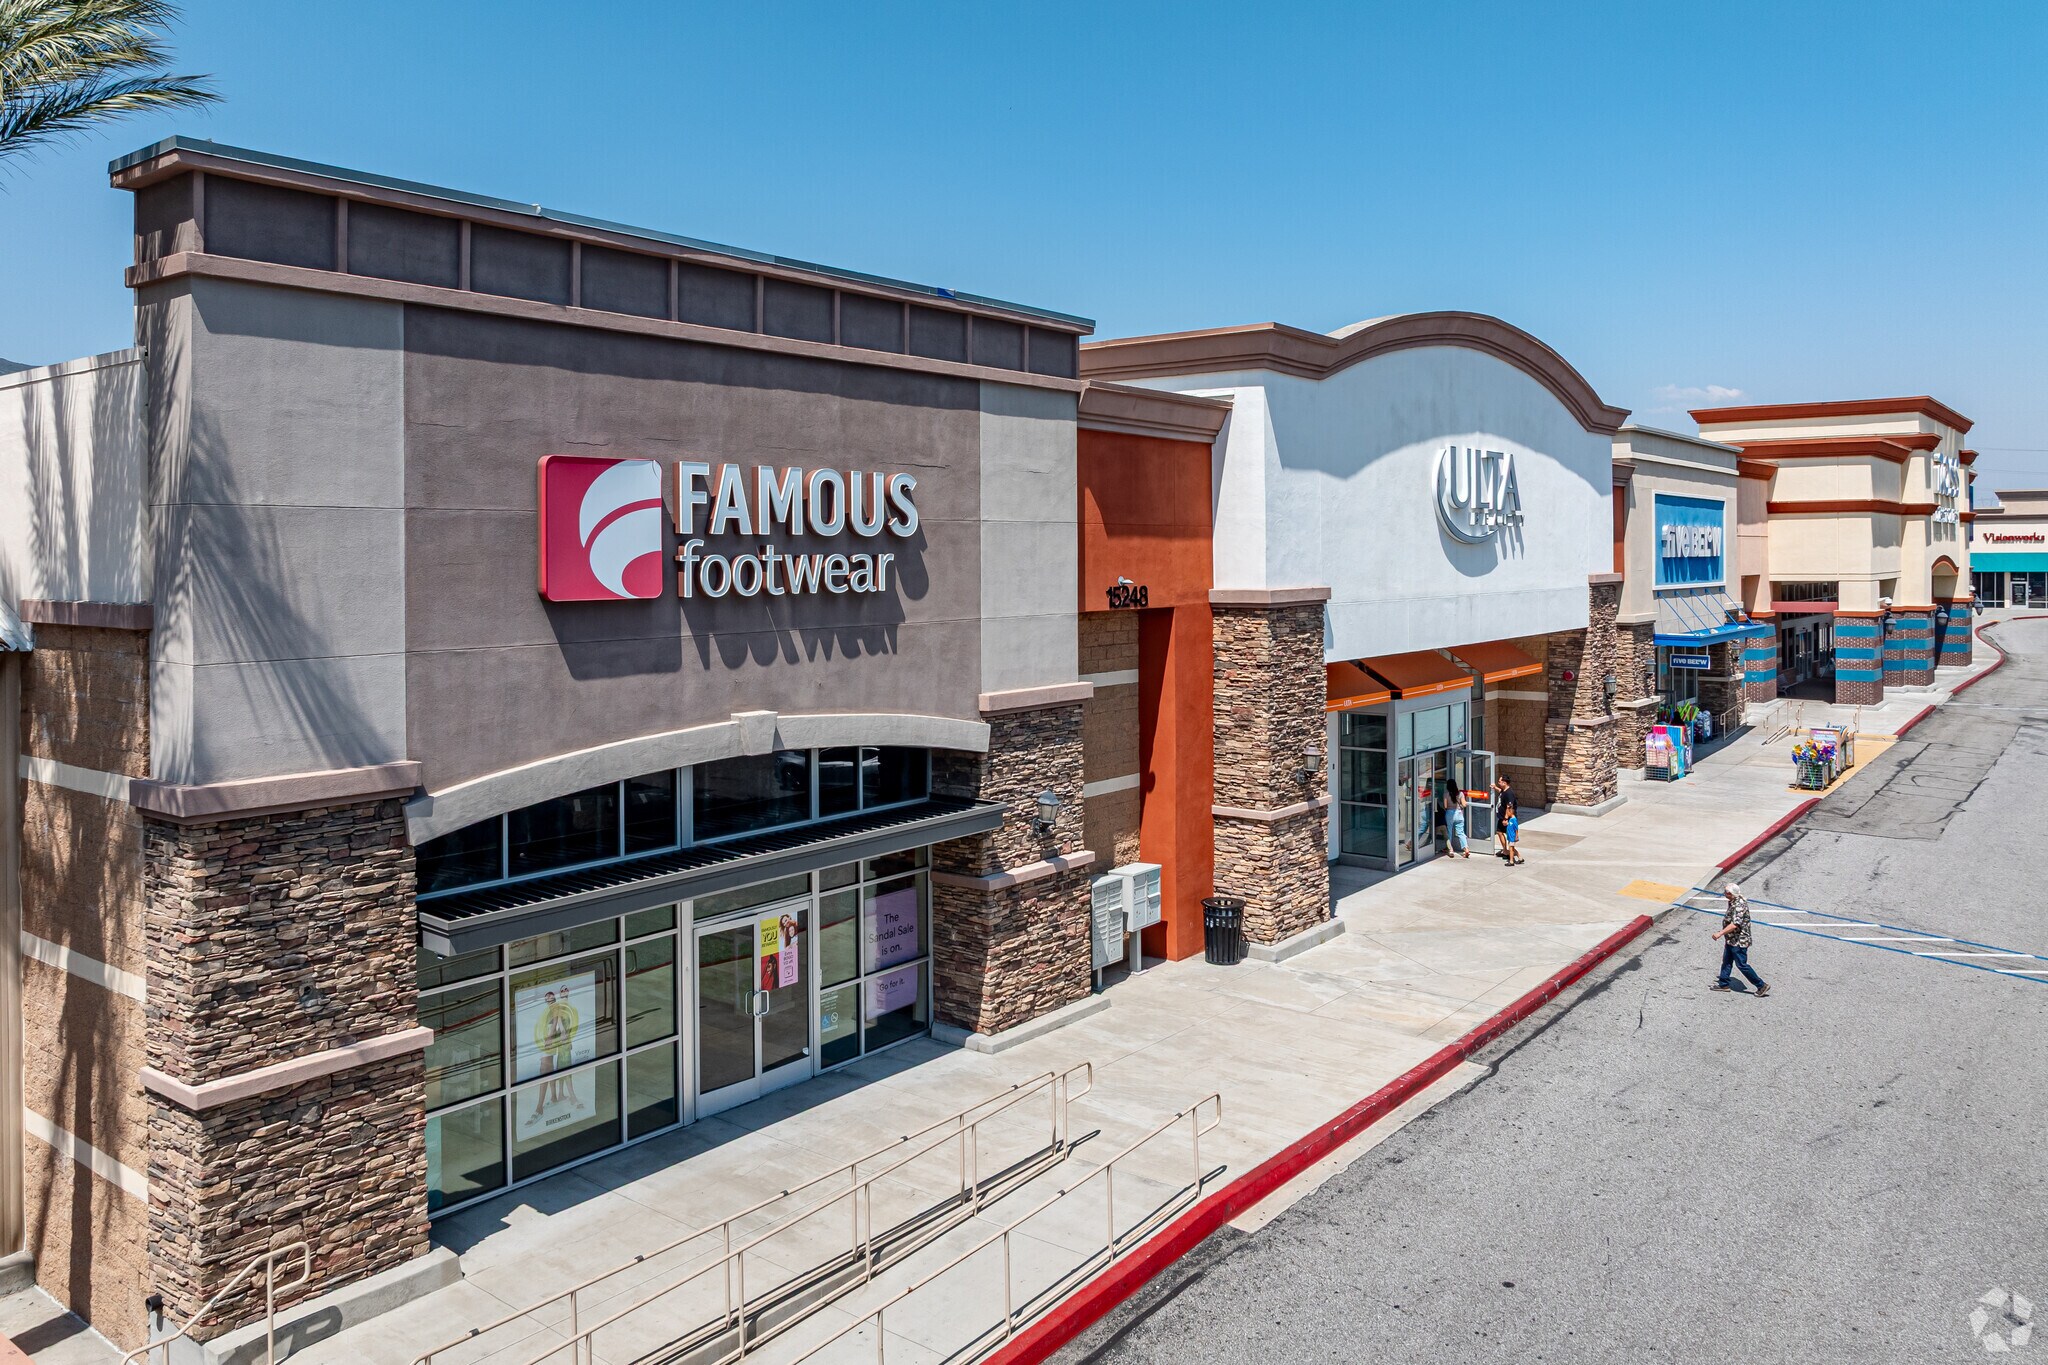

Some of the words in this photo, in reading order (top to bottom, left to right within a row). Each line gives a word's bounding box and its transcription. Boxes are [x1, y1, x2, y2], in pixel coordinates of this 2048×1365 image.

[1445, 446, 1521, 510] ULTA
[673, 460, 918, 537] FAMOUS
[1662, 525, 1689, 557] five
[1983, 532, 2045, 542] Visionworks
[675, 538, 894, 598] footwear
[1106, 585, 1148, 608] 15248
[884, 913, 899, 924] The
[762, 930, 778, 942] YOU
[869, 927, 896, 944] Sandal
[897, 923, 914, 936] Sale
[881, 946, 888, 956] is
[889, 944, 902, 953] on.
[879, 983, 888, 992] Go
[889, 980, 898, 988] for
